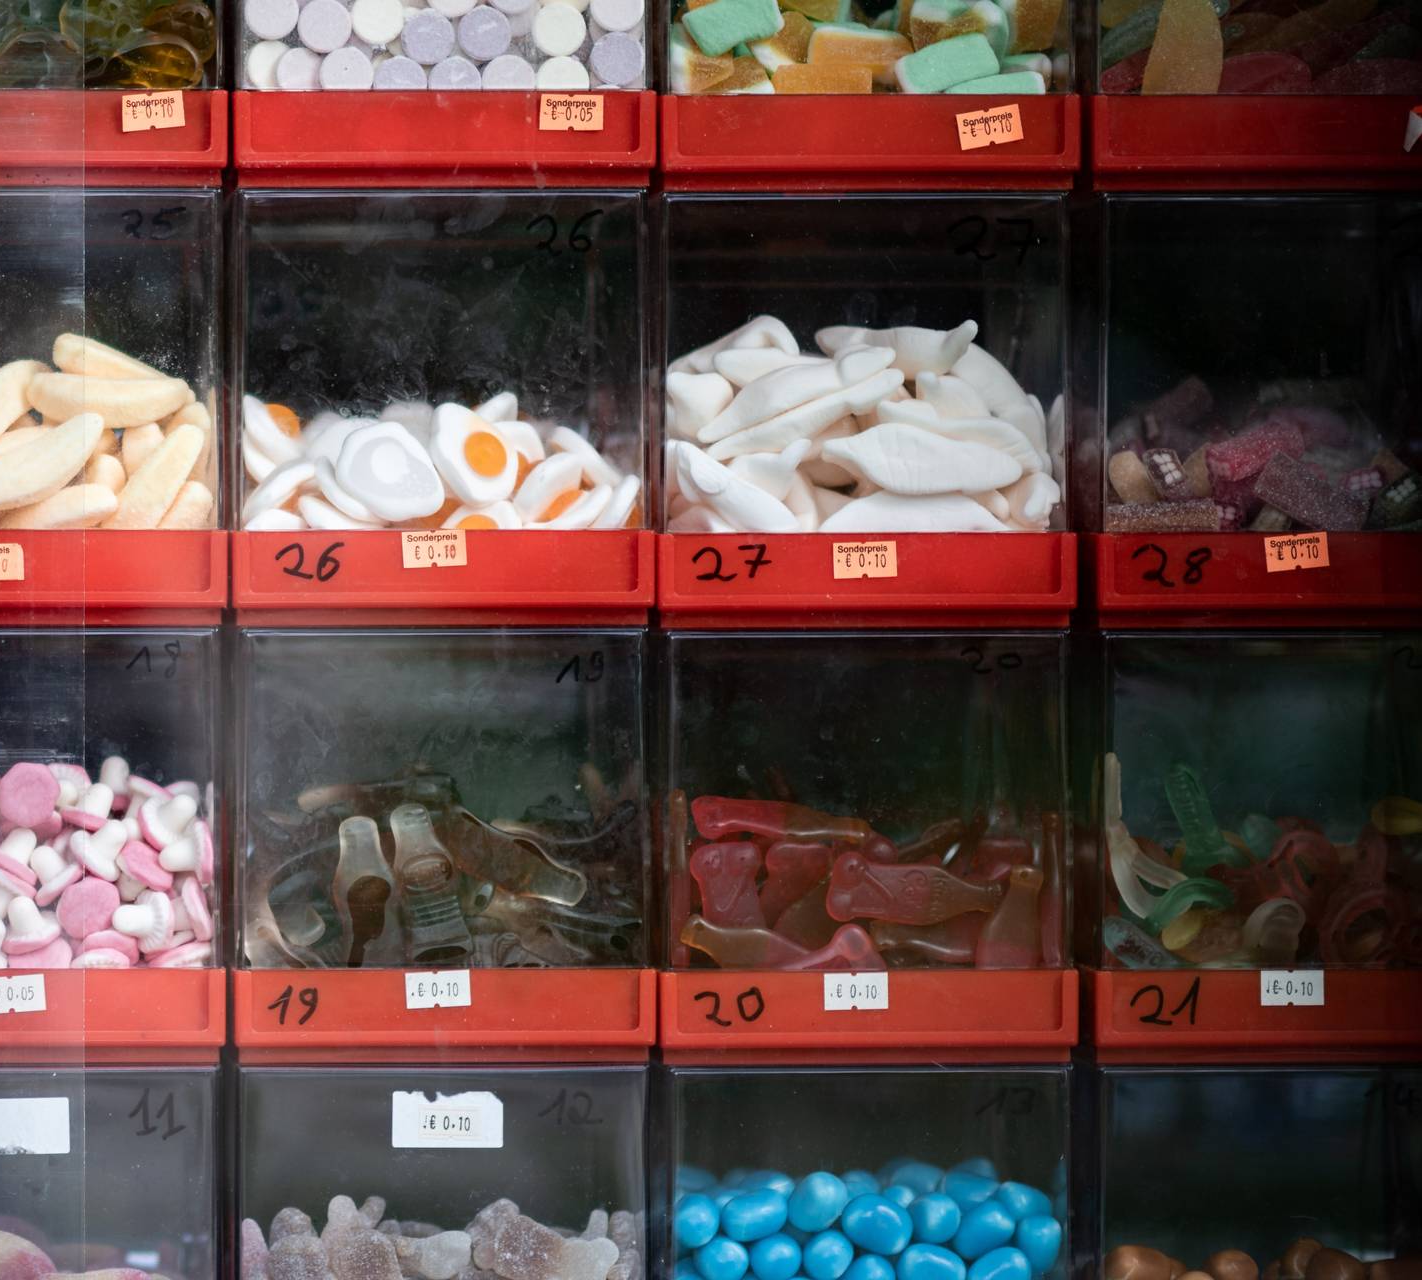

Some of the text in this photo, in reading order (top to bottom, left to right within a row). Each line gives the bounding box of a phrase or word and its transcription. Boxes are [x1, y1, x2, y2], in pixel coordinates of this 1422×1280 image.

[126, 96, 176, 108] Sonderpreis
[545, 98, 597, 108] Sonderpreis
[962, 111, 1013, 128] Sonderpreis
[120, 205, 188, 240] 25
[525, 209, 604, 257] 26
[946, 215, 1049, 266] 27
[406, 532, 458, 544] Sonderpreis
[837, 544, 888, 555] Sonderpreis
[1269, 535, 1320, 549] Sonderpreis
[274, 542, 345, 584] 26
[691, 543, 773, 582] 27
[1131, 543, 1213, 588] 28
[125, 639, 182, 680] 18
[555, 650, 605, 684] 19
[960, 645, 1024, 675] 20
[268, 985, 319, 1026] 19
[694, 986, 766, 1028] 20
[1129, 976, 1201, 1026] 21
[128, 1087, 187, 1141] 11
[537, 1088, 605, 1126] 12
[974, 1085, 1038, 1117] 13
